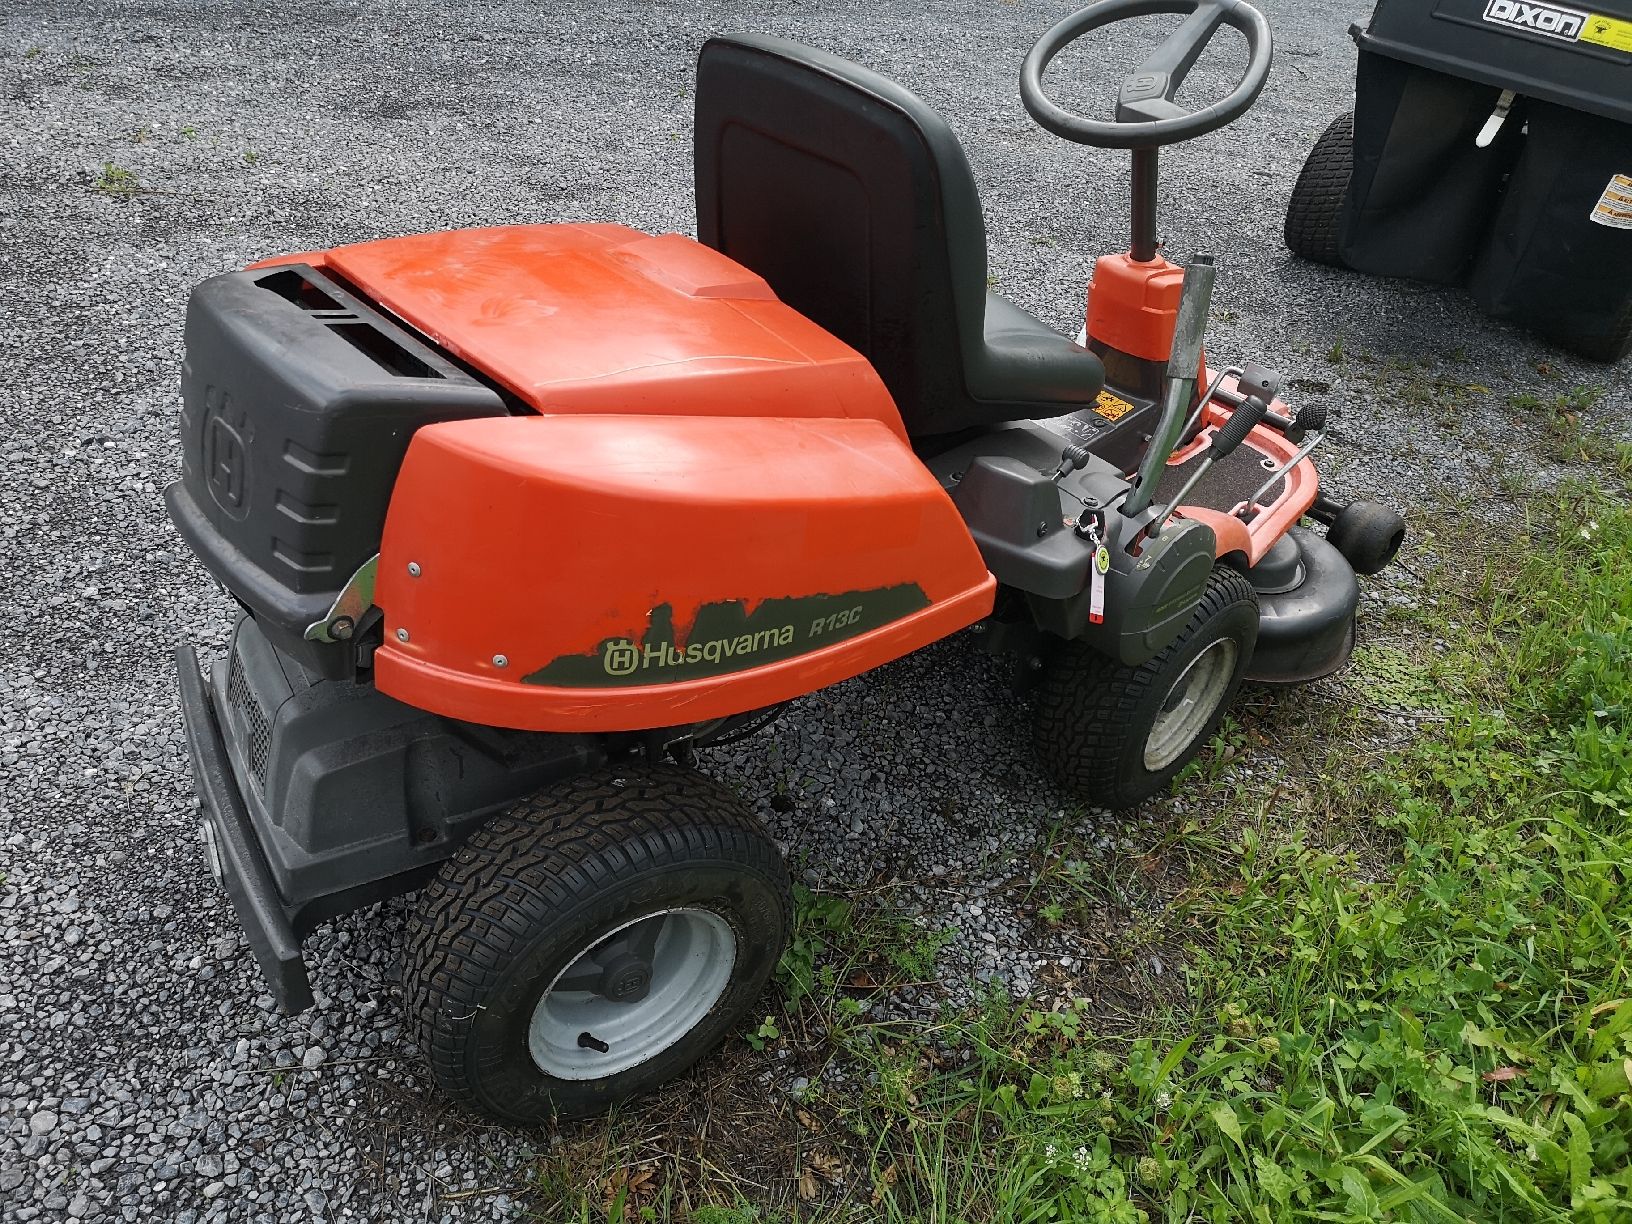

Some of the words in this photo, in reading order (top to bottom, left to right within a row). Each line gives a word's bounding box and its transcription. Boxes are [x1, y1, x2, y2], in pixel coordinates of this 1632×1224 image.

[1489, 0, 1581, 37] DIXON
[642, 625, 794, 669] Husqvarna
[808, 606, 863, 638] R13C
